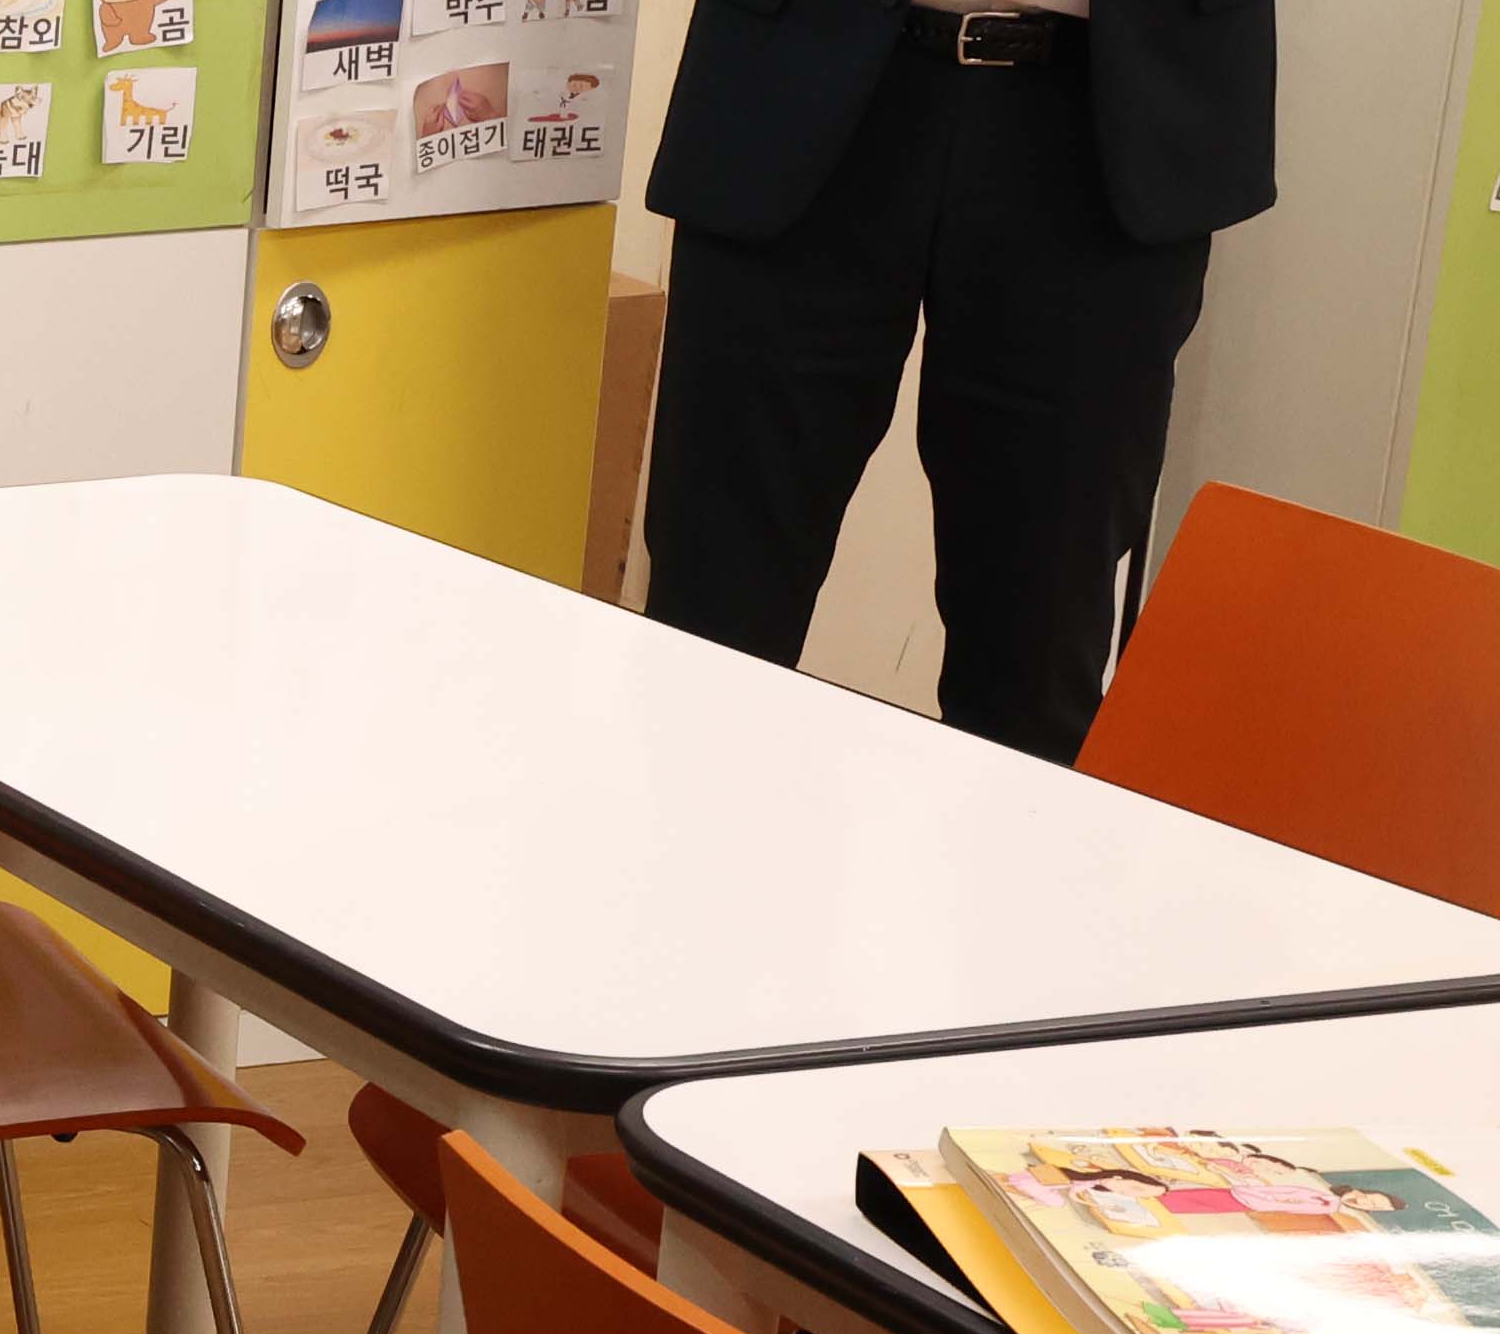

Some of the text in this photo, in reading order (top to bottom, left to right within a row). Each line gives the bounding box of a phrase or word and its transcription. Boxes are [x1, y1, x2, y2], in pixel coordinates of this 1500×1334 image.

[156, 8, 190, 45] 곰
[332, 41, 395, 82] 새벽
[125, 125, 189, 159] 기린
[417, 121, 507, 170] 종이접기
[522, 124, 602, 159] 태권도
[325, 163, 384, 201] 떡국
